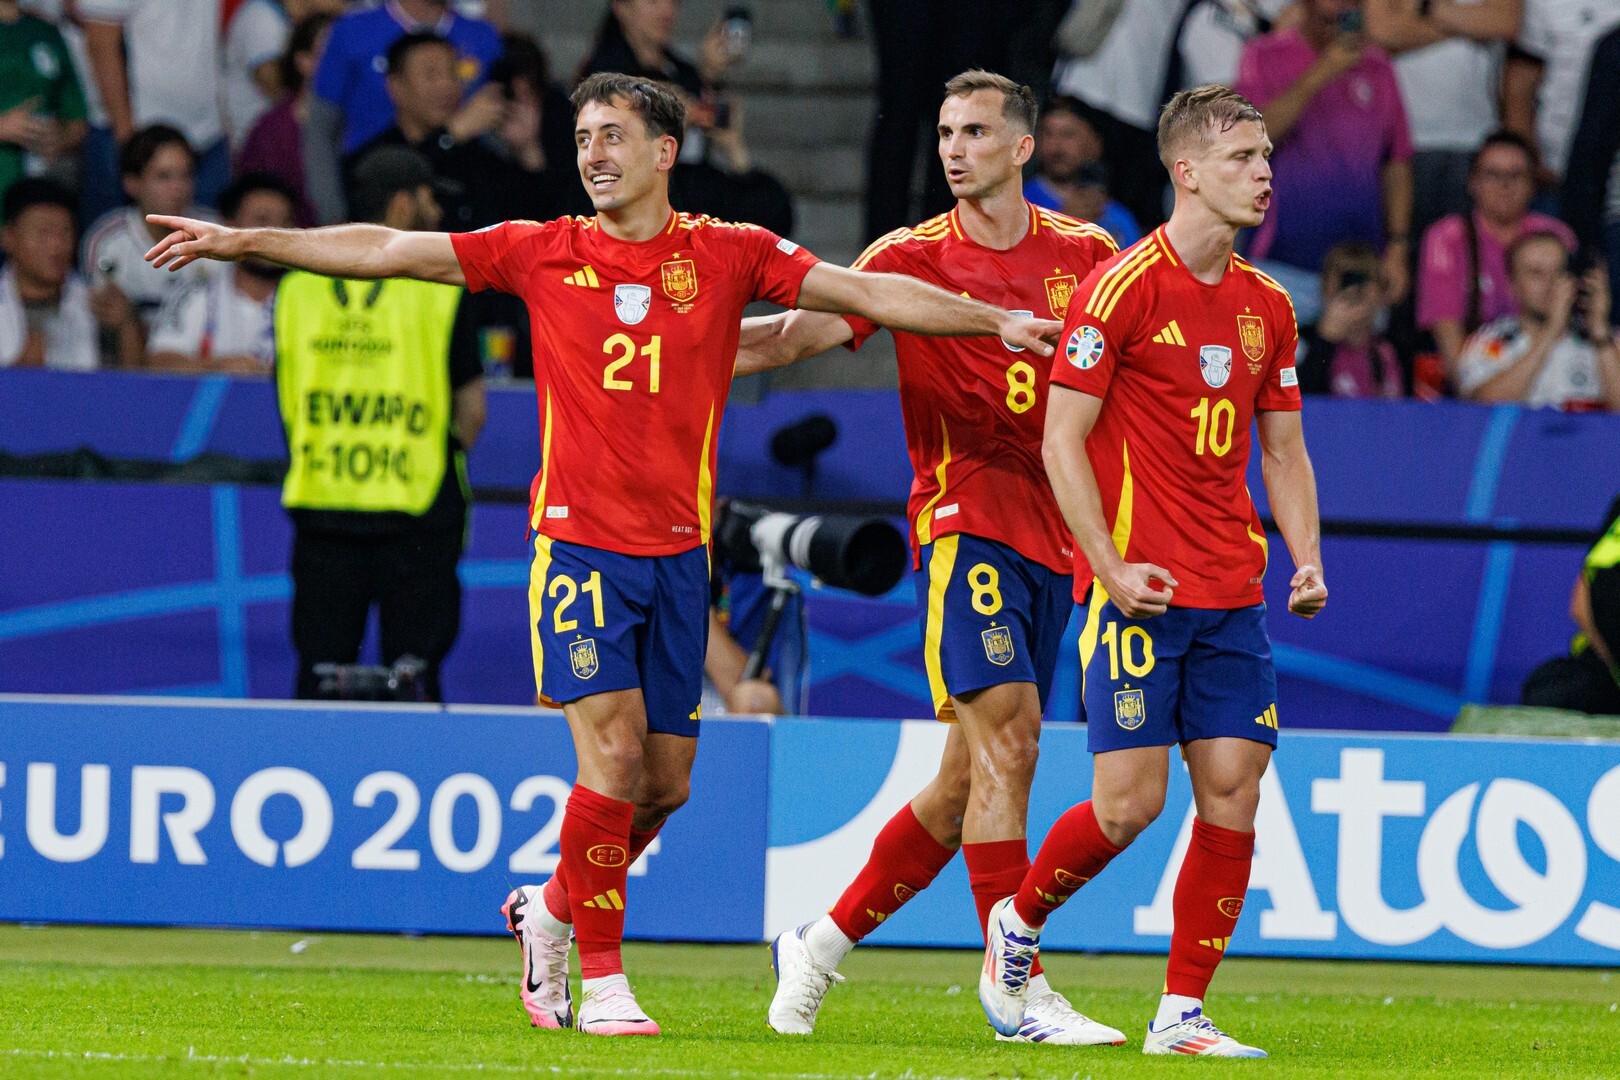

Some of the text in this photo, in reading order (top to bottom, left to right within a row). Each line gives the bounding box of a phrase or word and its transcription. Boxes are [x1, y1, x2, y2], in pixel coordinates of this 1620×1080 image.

[603, 333, 661, 393] 21
[1005, 360, 1036, 414] 8
[1191, 398, 1235, 457] 10
[548, 571, 604, 633] 21
[967, 562, 1003, 616] 8
[1101, 622, 1155, 680] 10
[0, 762, 662, 876] URO 202
